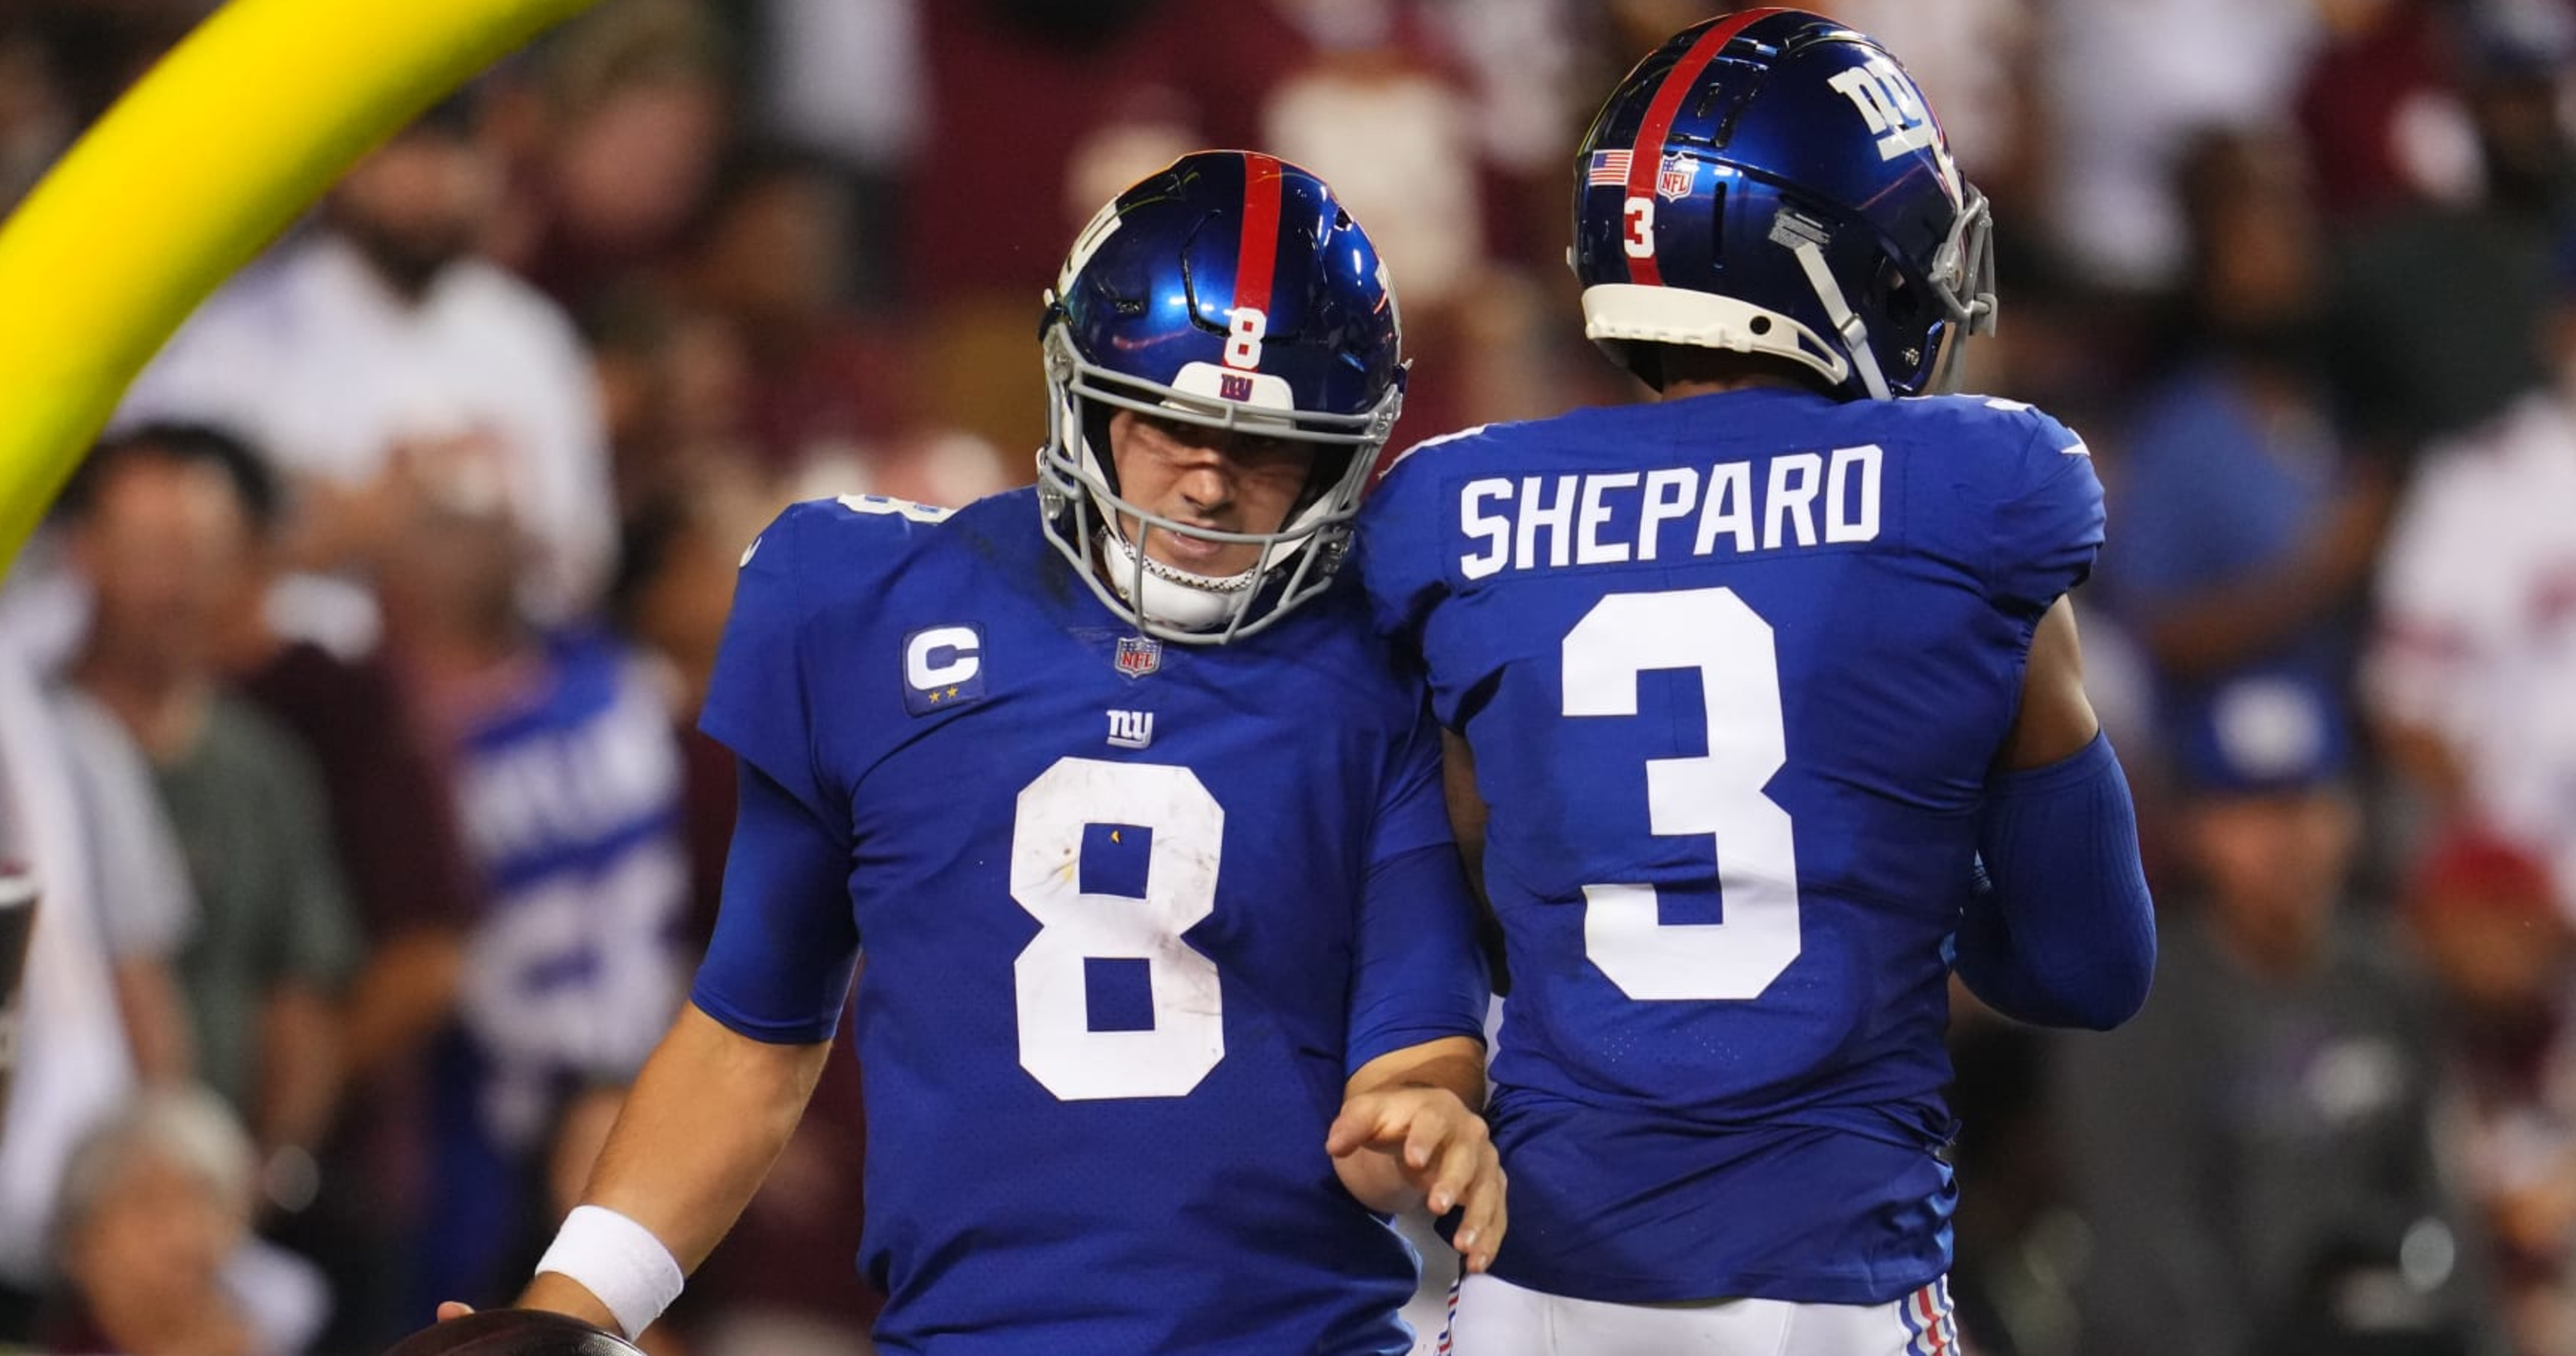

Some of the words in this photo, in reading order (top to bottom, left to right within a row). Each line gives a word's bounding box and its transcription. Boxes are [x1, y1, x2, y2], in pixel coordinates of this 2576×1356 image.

[1662, 173, 1687, 193] NFL
[1624, 197, 1655, 258] 3
[1223, 306, 1267, 370] 8
[1460, 444, 1883, 580] SHEPARD
[907, 626, 980, 690] C
[1121, 651, 1155, 671] NFL
[1562, 586, 1802, 1000] 3
[1009, 756, 1226, 1101] 8
